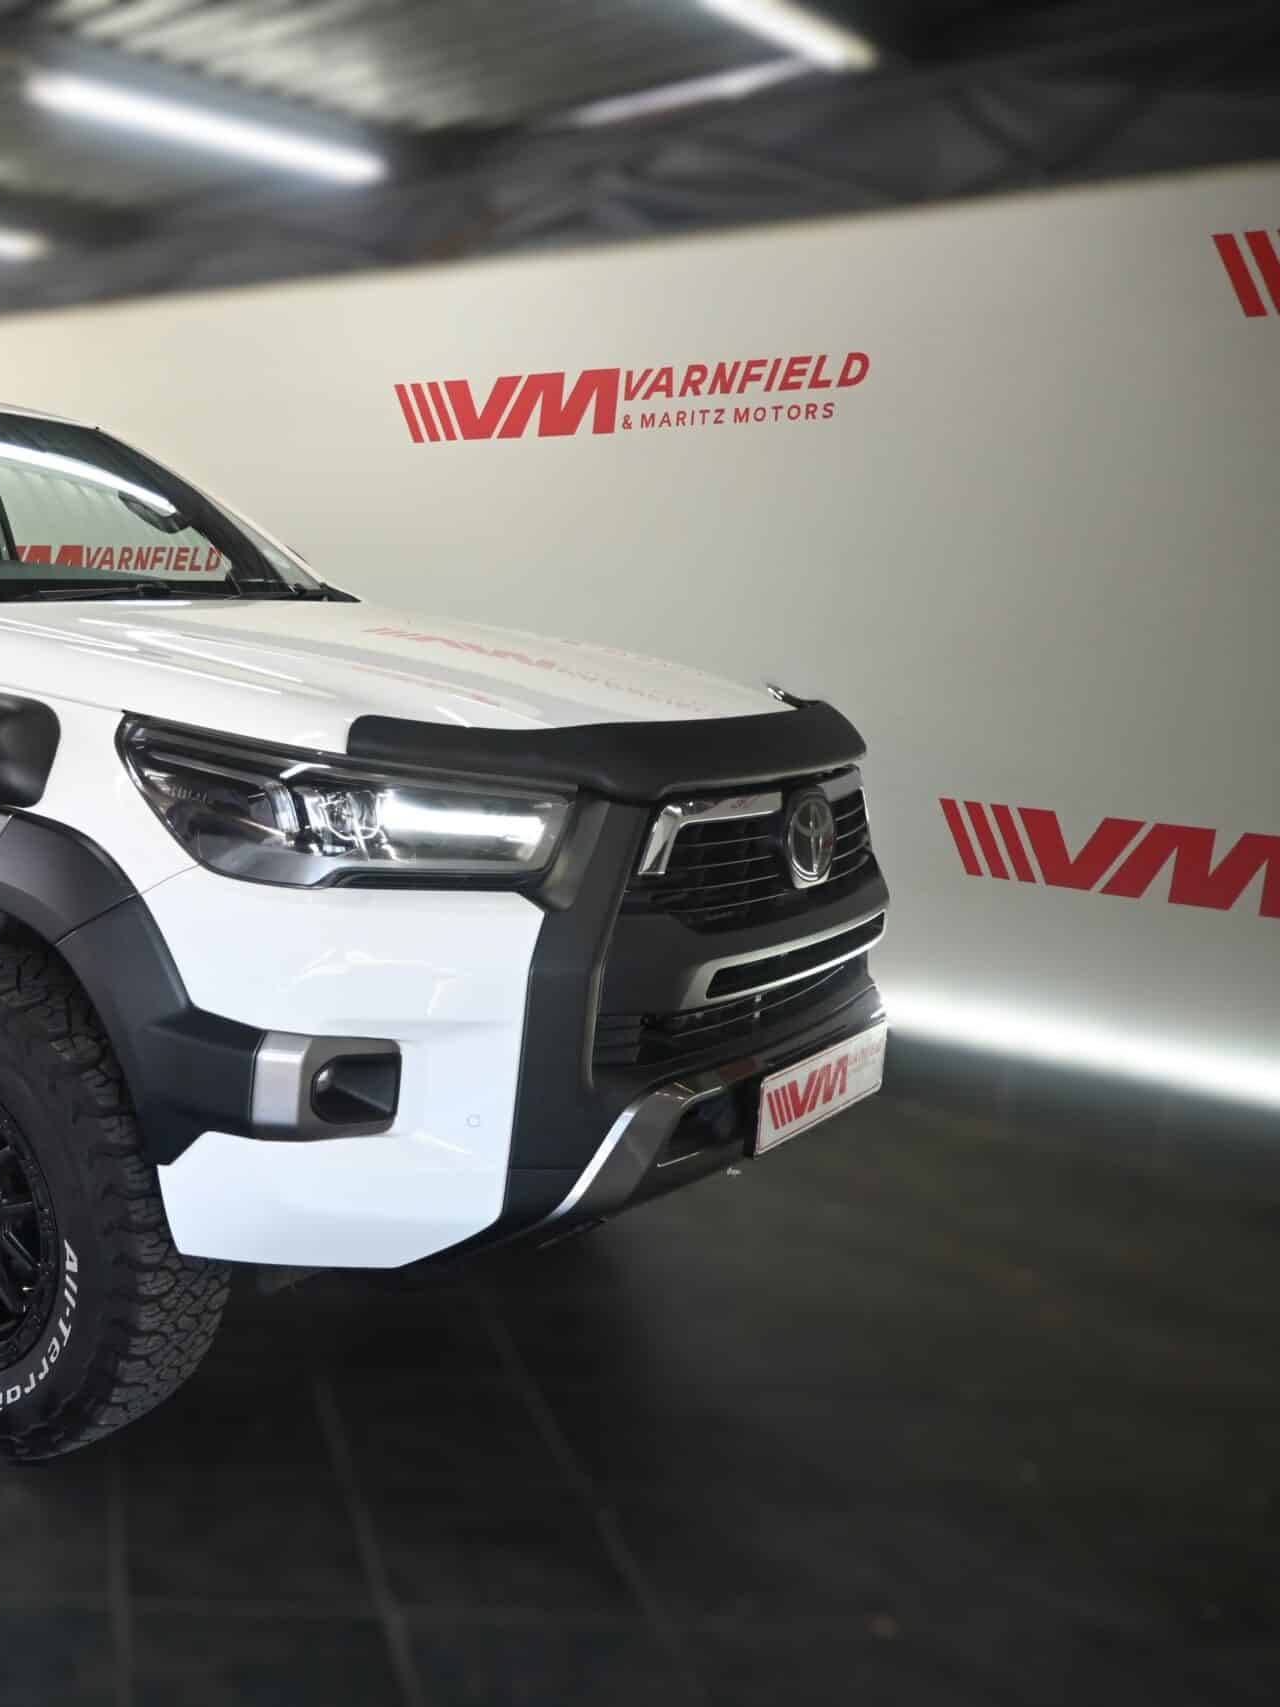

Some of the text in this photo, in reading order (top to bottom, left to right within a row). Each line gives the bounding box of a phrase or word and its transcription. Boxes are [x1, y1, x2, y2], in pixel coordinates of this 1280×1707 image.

[623, 351, 871, 402] VARNFIELD
[621, 402, 836, 431] & MARITZ MOTORS
[85, 545, 226, 572] VARNFIELD
